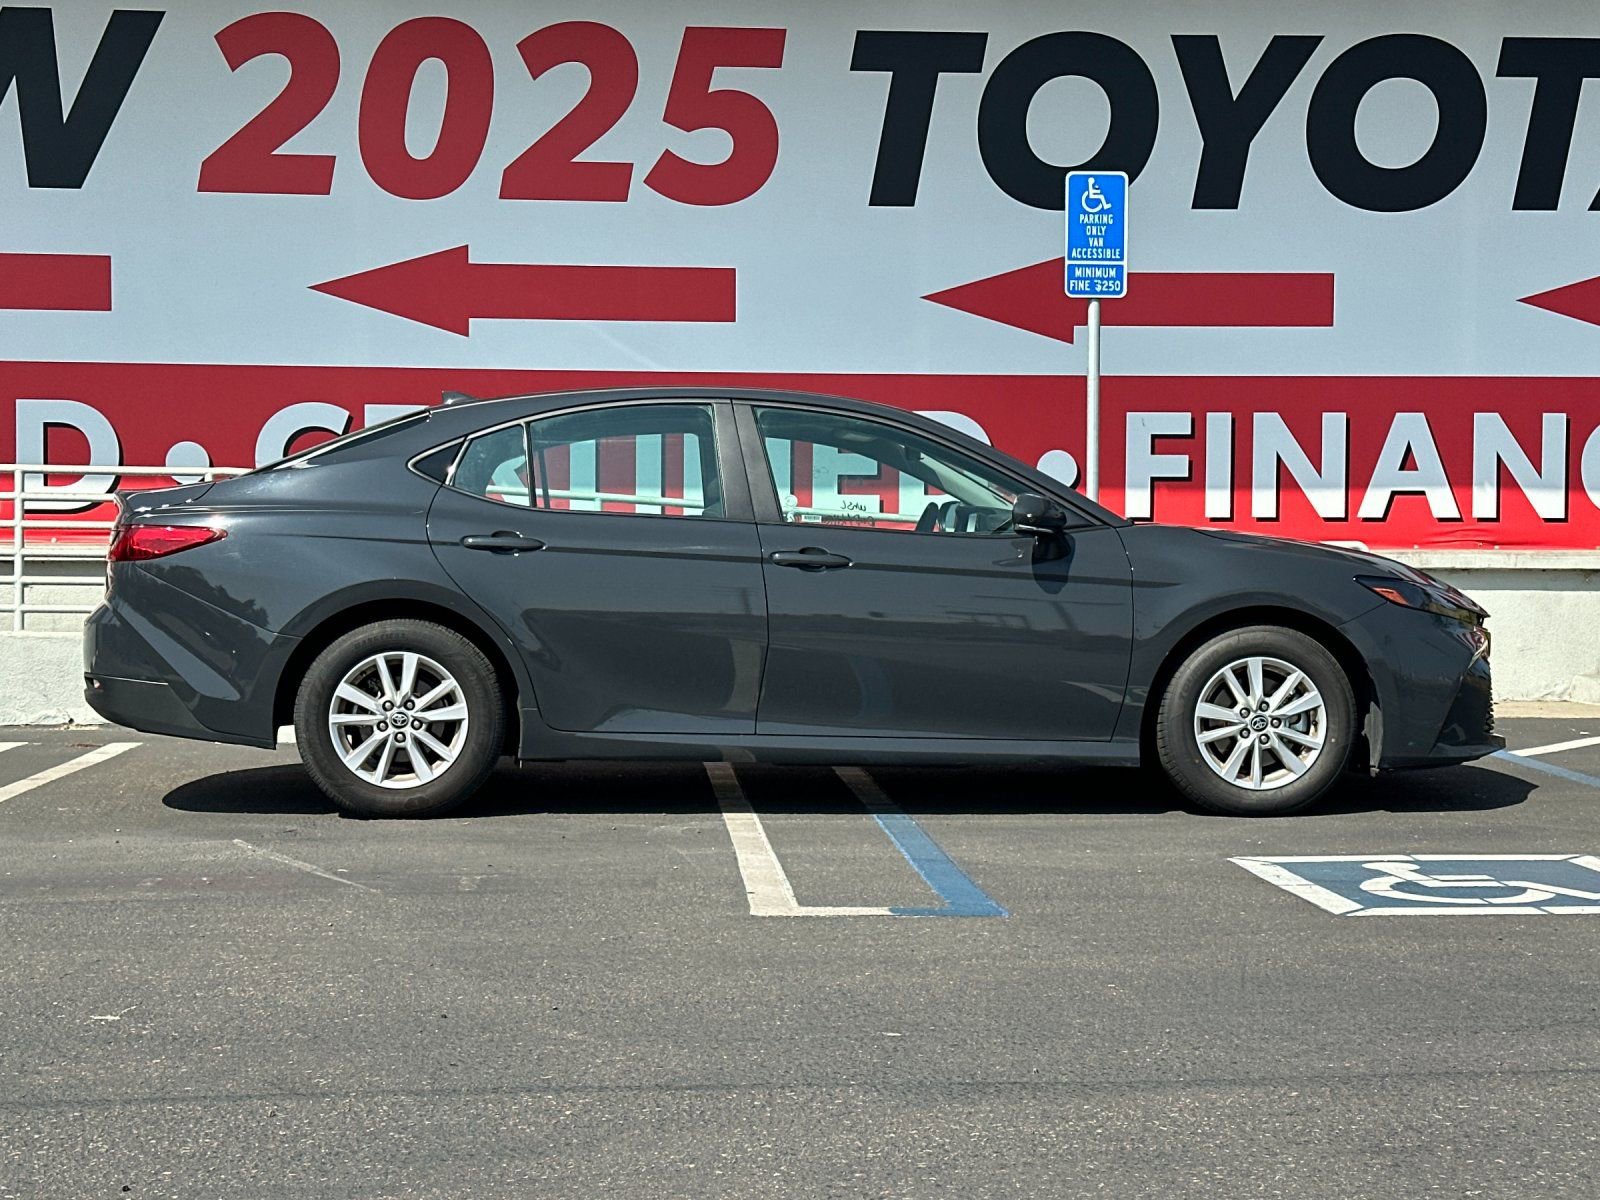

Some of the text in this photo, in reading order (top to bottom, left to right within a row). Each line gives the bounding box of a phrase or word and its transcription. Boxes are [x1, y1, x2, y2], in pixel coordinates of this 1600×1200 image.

[197, 11, 787, 206] 2025
[850, 30, 1600, 213] TOYOT
[1080, 214, 1113, 224] PARKING
[1086, 226, 1107, 236] ONLY
[1088, 238, 1104, 247] VAN
[1071, 248, 1120, 259] ACCESSIBLE
[1075, 267, 1116, 278] MINIMUM
[1069, 280, 1090, 291] FINE
[1124, 410, 1600, 523] FINAN
